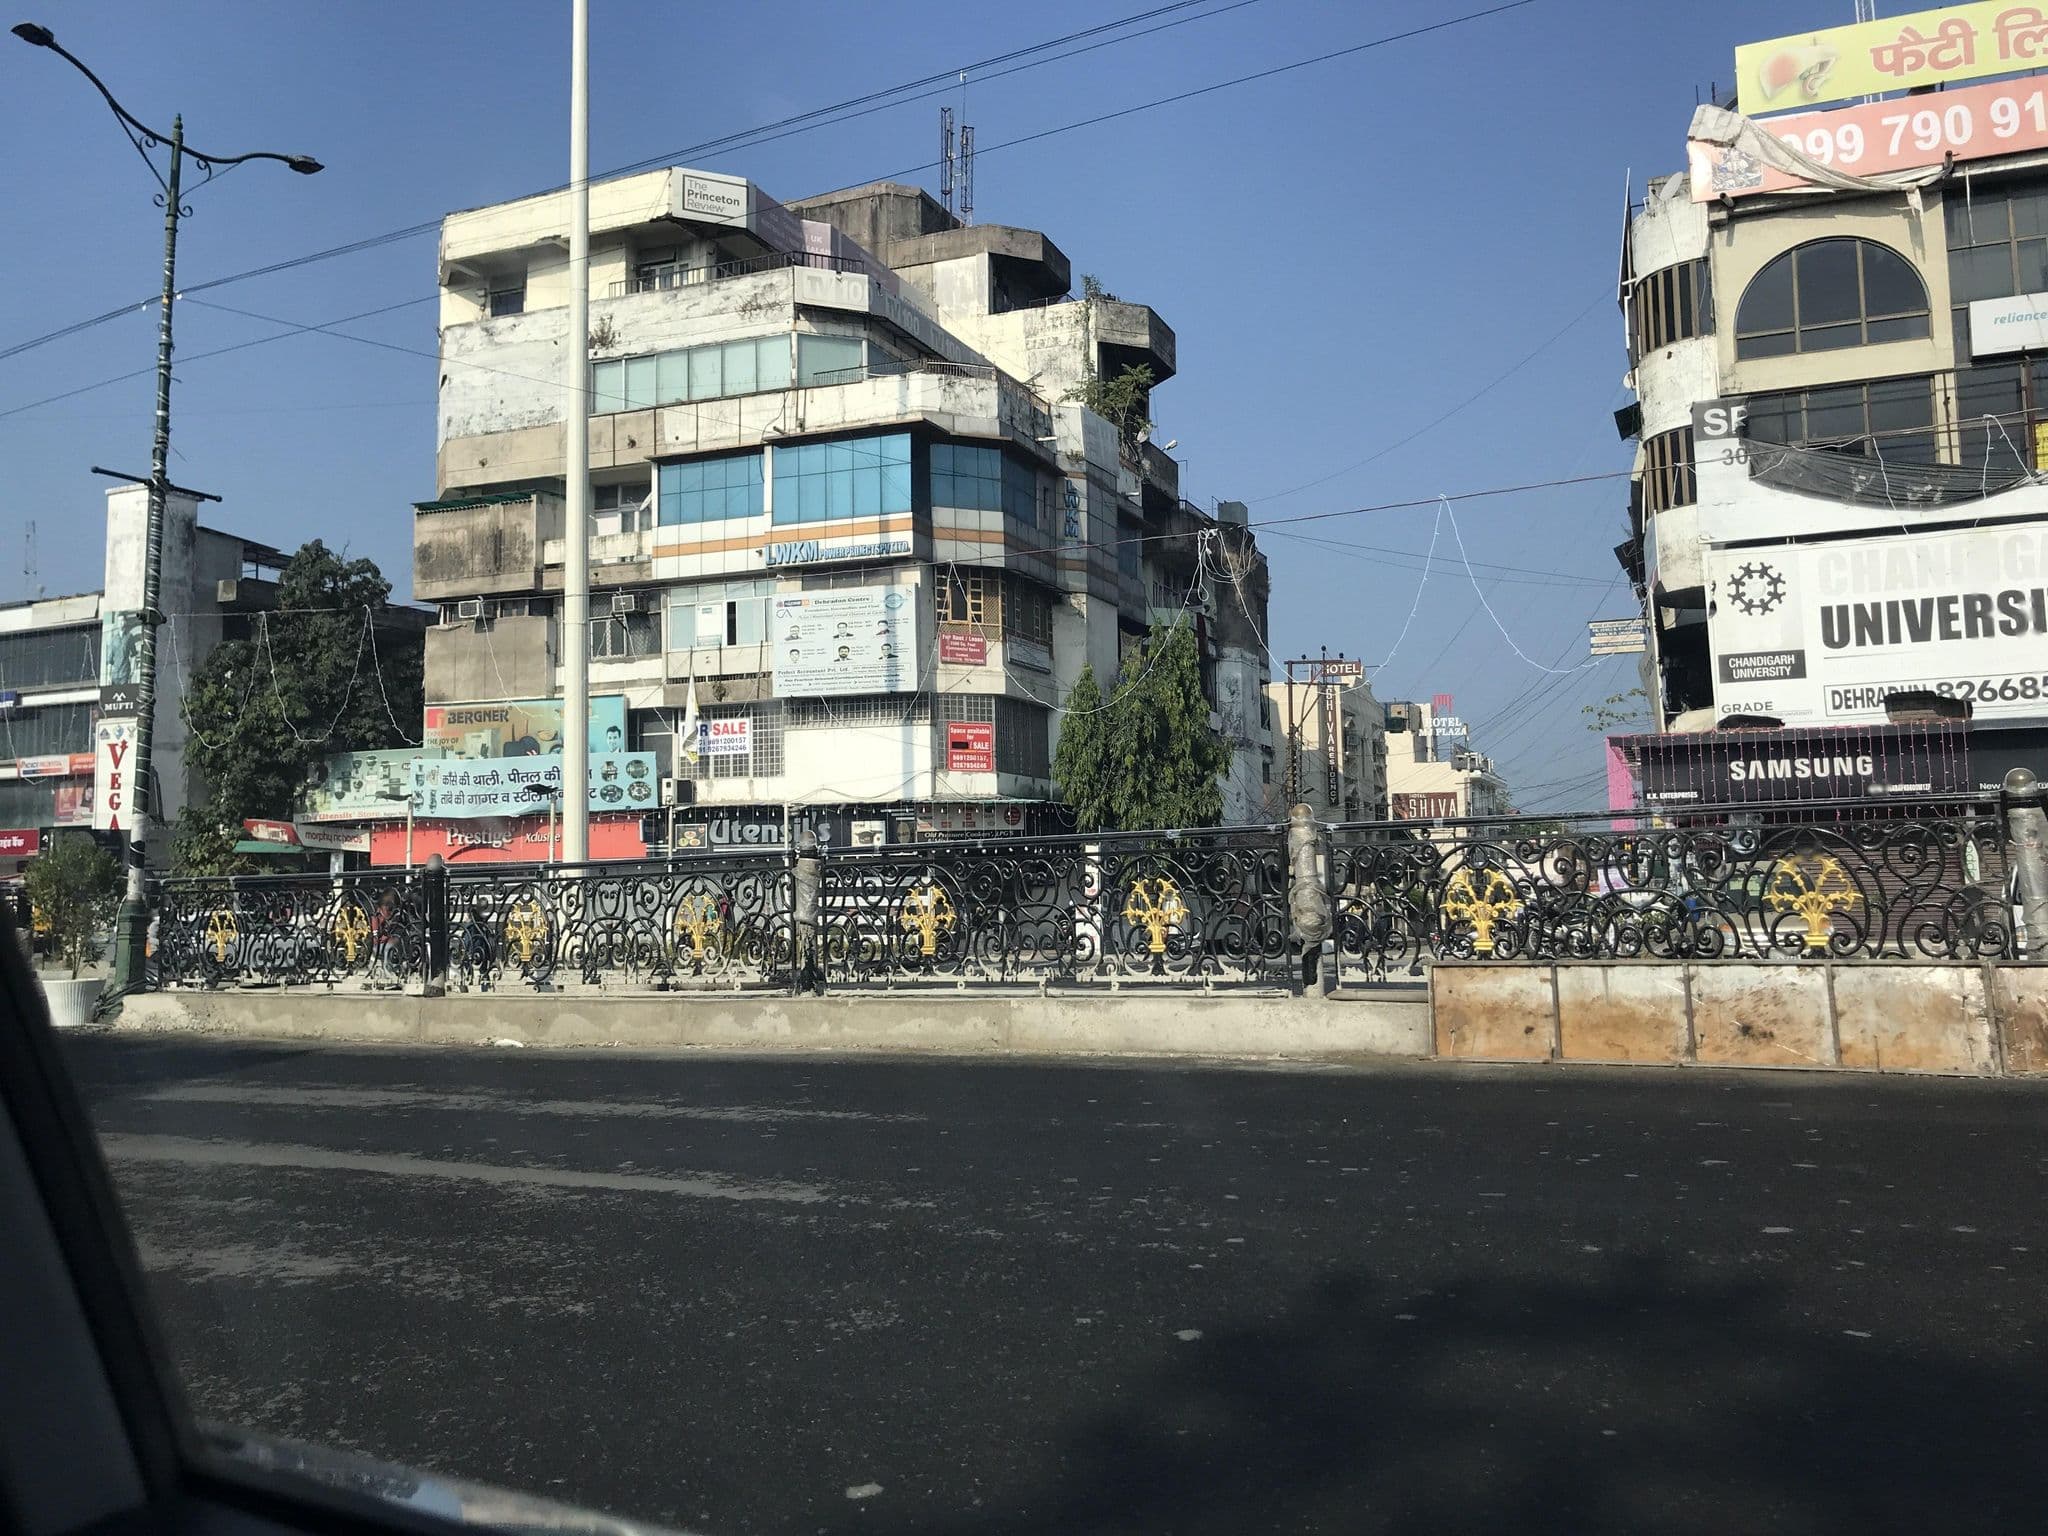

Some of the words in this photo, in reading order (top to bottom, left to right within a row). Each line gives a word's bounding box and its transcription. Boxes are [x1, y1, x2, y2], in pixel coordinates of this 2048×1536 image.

[1881, 104, 1974, 156] 790
[1988, 91, 2047, 138] 91
[688, 179, 708, 192] The
[687, 189, 740, 206] Princeton
[687, 198, 725, 213] Review
[1993, 311, 2047, 325] reliance
[765, 541, 819, 566] LWKM
[1728, 654, 1795, 668] CHANDIGARH
[1732, 666, 1792, 679] UNIVERSITY
[104, 701, 133, 711] MUFTI
[1721, 701, 1774, 714] GRADE
[447, 709, 509, 725] BERGNER
[1326, 689, 1335, 745] SHIVA
[712, 721, 747, 736] SALE
[1435, 725, 1467, 737] PLAZA
[973, 741, 989, 749] SALE
[1730, 755, 1873, 781] SAMSUNG
[507, 768, 539, 785] पीतल
[544, 767, 560, 781] की
[107, 740, 128, 830] VEGA
[1979, 782, 2001, 790] New
[467, 793, 498, 806] गागर
[501, 792, 510, 803] व
[1659, 791, 1699, 799] ENTERPRISES
[1409, 798, 1457, 818] SHIVA
[305, 831, 332, 843] morphy
[446, 826, 513, 848] Prestige
